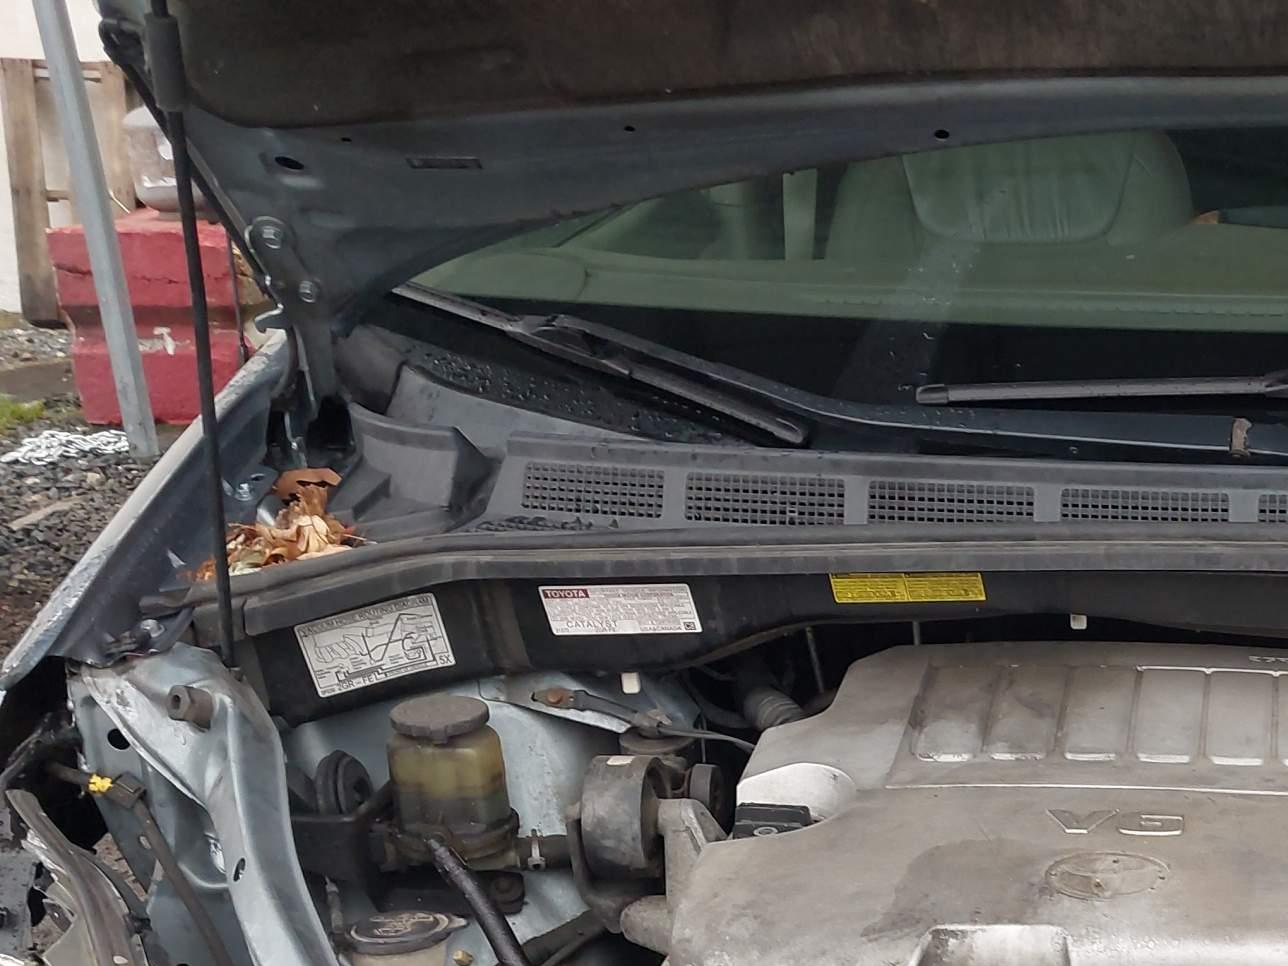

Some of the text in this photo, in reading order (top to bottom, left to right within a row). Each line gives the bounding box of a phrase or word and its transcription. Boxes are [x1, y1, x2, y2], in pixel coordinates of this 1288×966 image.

[545, 588, 583, 597] TOYOTA
[566, 620, 617, 628] CATALYST
[1044, 807, 1185, 838] V6
